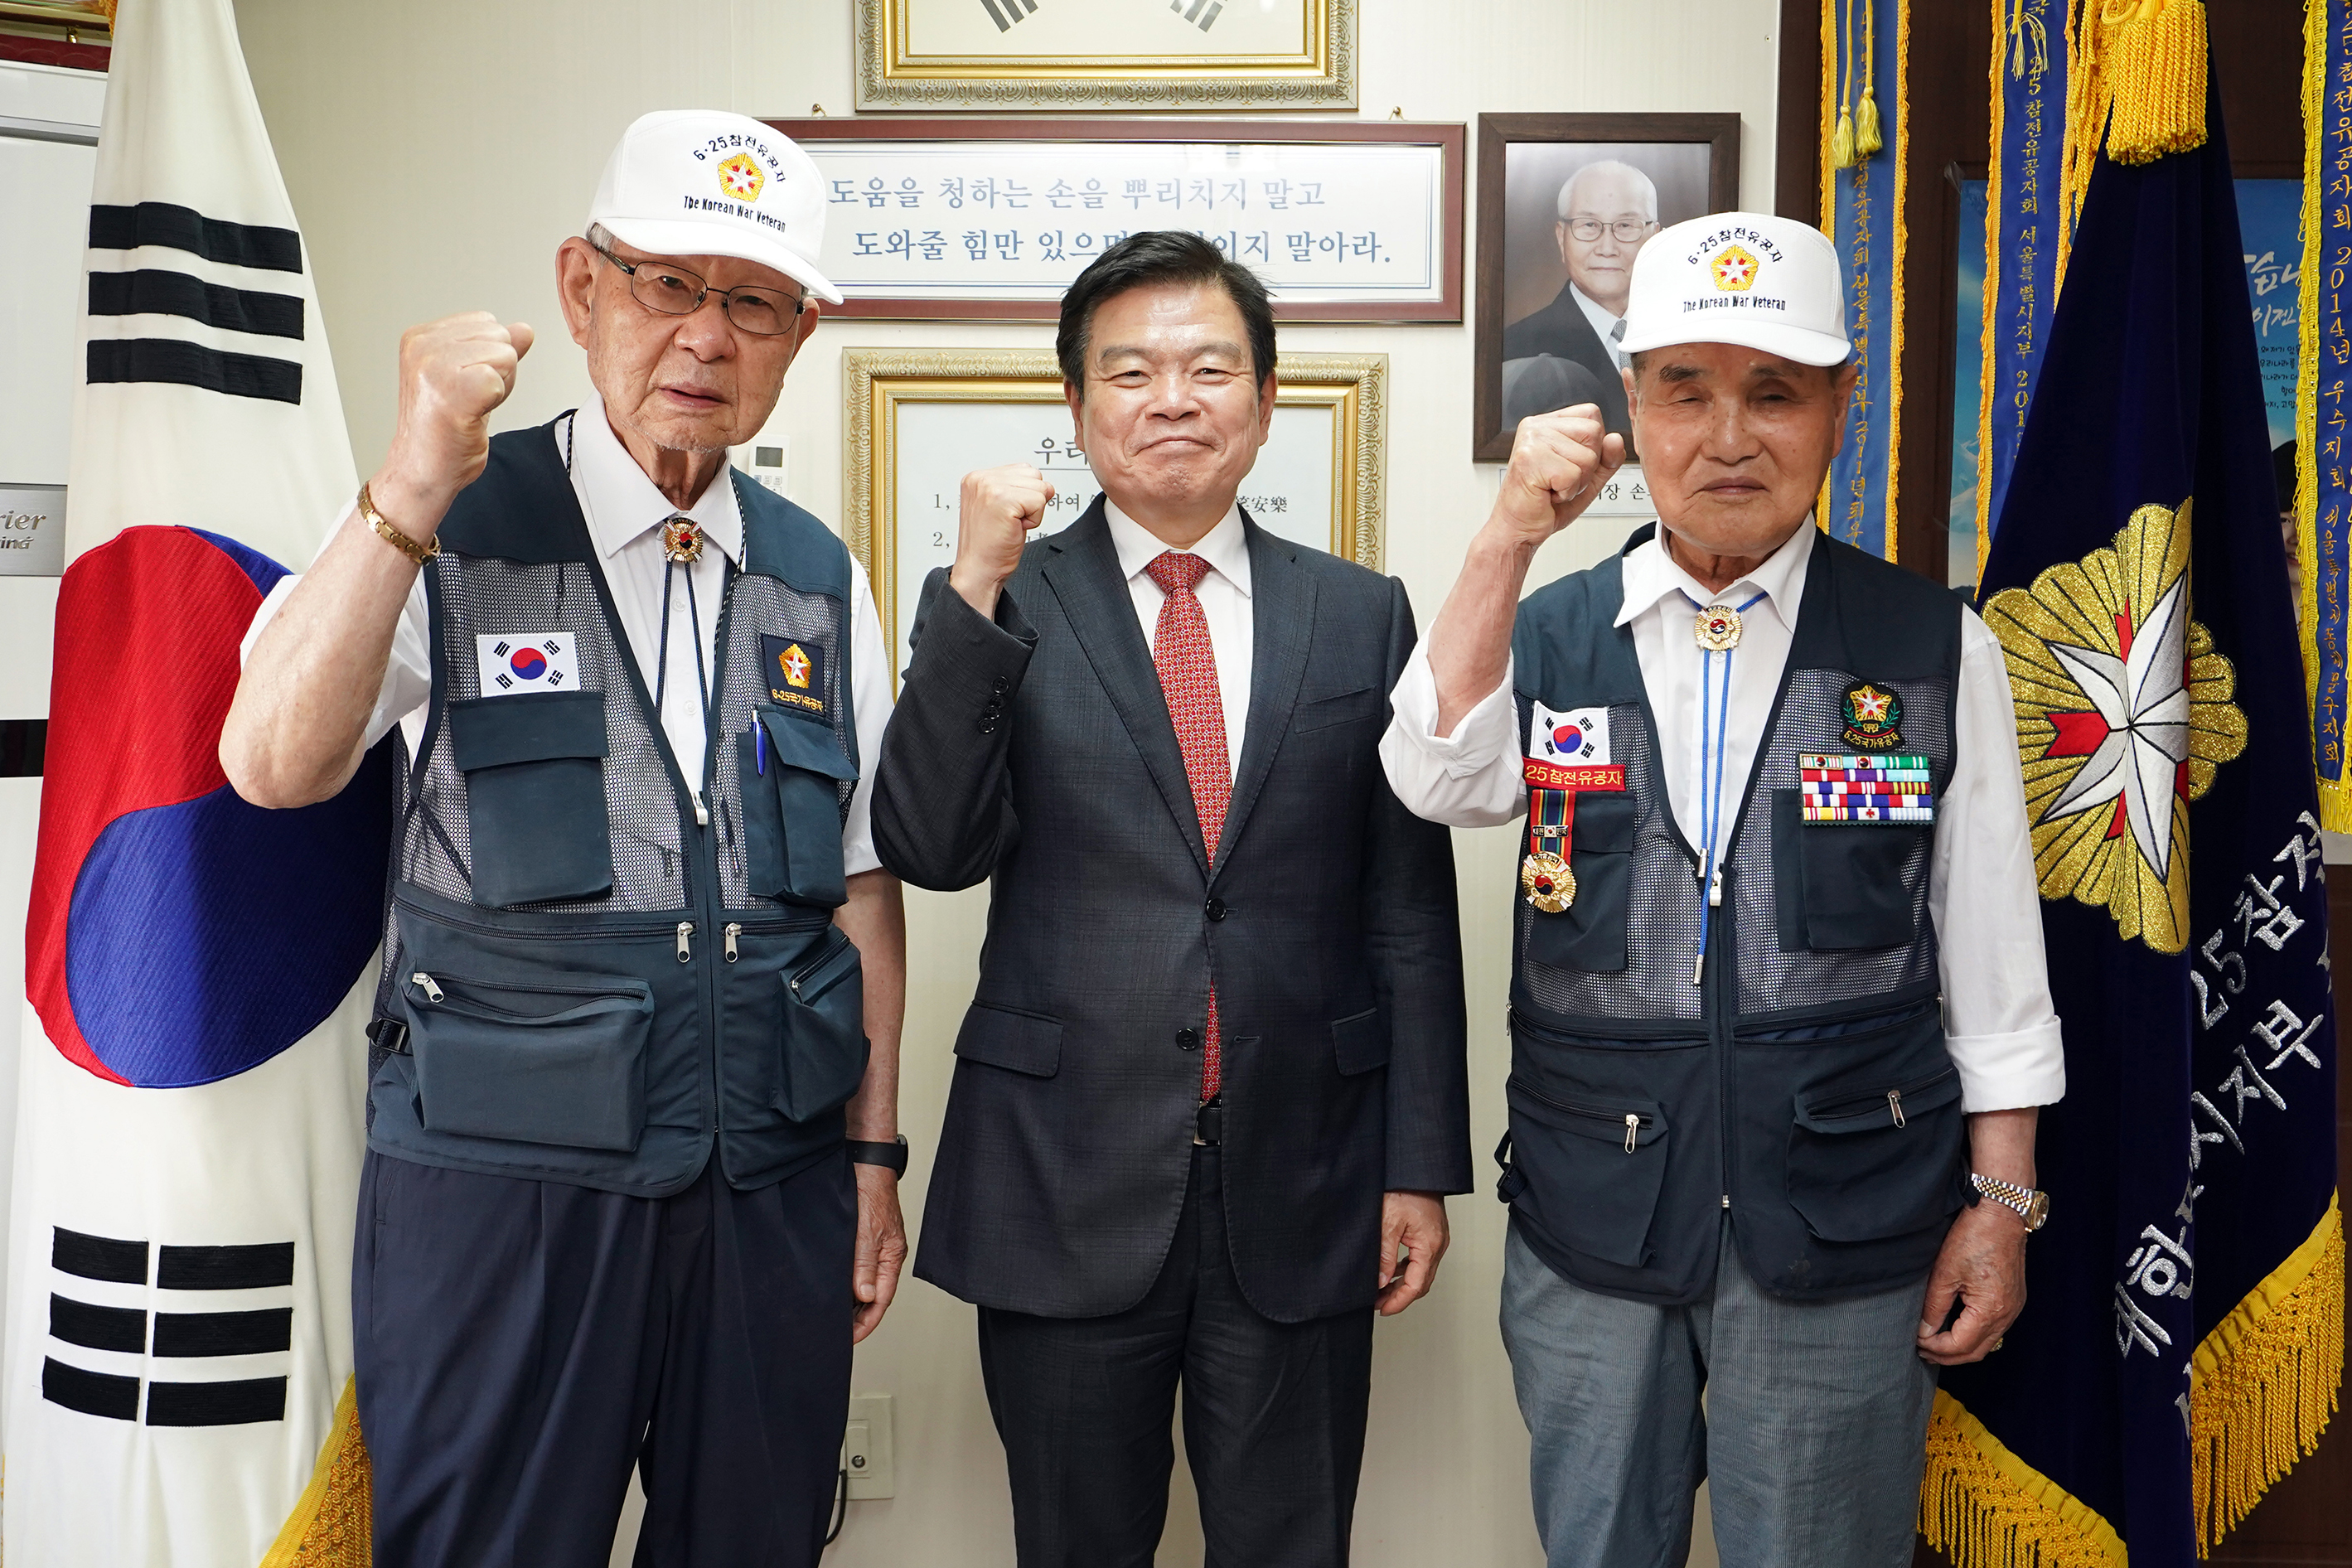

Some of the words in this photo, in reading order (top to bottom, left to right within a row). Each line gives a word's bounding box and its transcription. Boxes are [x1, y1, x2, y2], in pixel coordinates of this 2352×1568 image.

[2020, 99, 2045, 215] 참전유공자회
[829, 177, 924, 208] 도움을
[938, 177, 1033, 209] 청하는
[1045, 177, 1109, 208] 손을
[1121, 177, 1246, 210] 뿌리치지
[1263, 177, 1326, 210] 말고
[702, 198, 734, 215] Korean
[737, 204, 754, 220] War
[757, 211, 786, 233] Veteran
[852, 229, 948, 261] 도와줄
[961, 229, 1024, 261] 힘만
[1197, 230, 1270, 264] 이지
[1286, 230, 1391, 264] 말아라.
[1683, 301, 1696, 313] The
[1699, 297, 1729, 310] Korean
[1733, 295, 1749, 307] War
[1753, 295, 1787, 311] Veteran
[2014, 225, 2038, 360] 서울특별시지부
[2013, 370, 2030, 461] 201
[933, 493, 951, 511] 1,
[1597, 482, 1621, 501] 장
[932, 530, 951, 549] 2,
